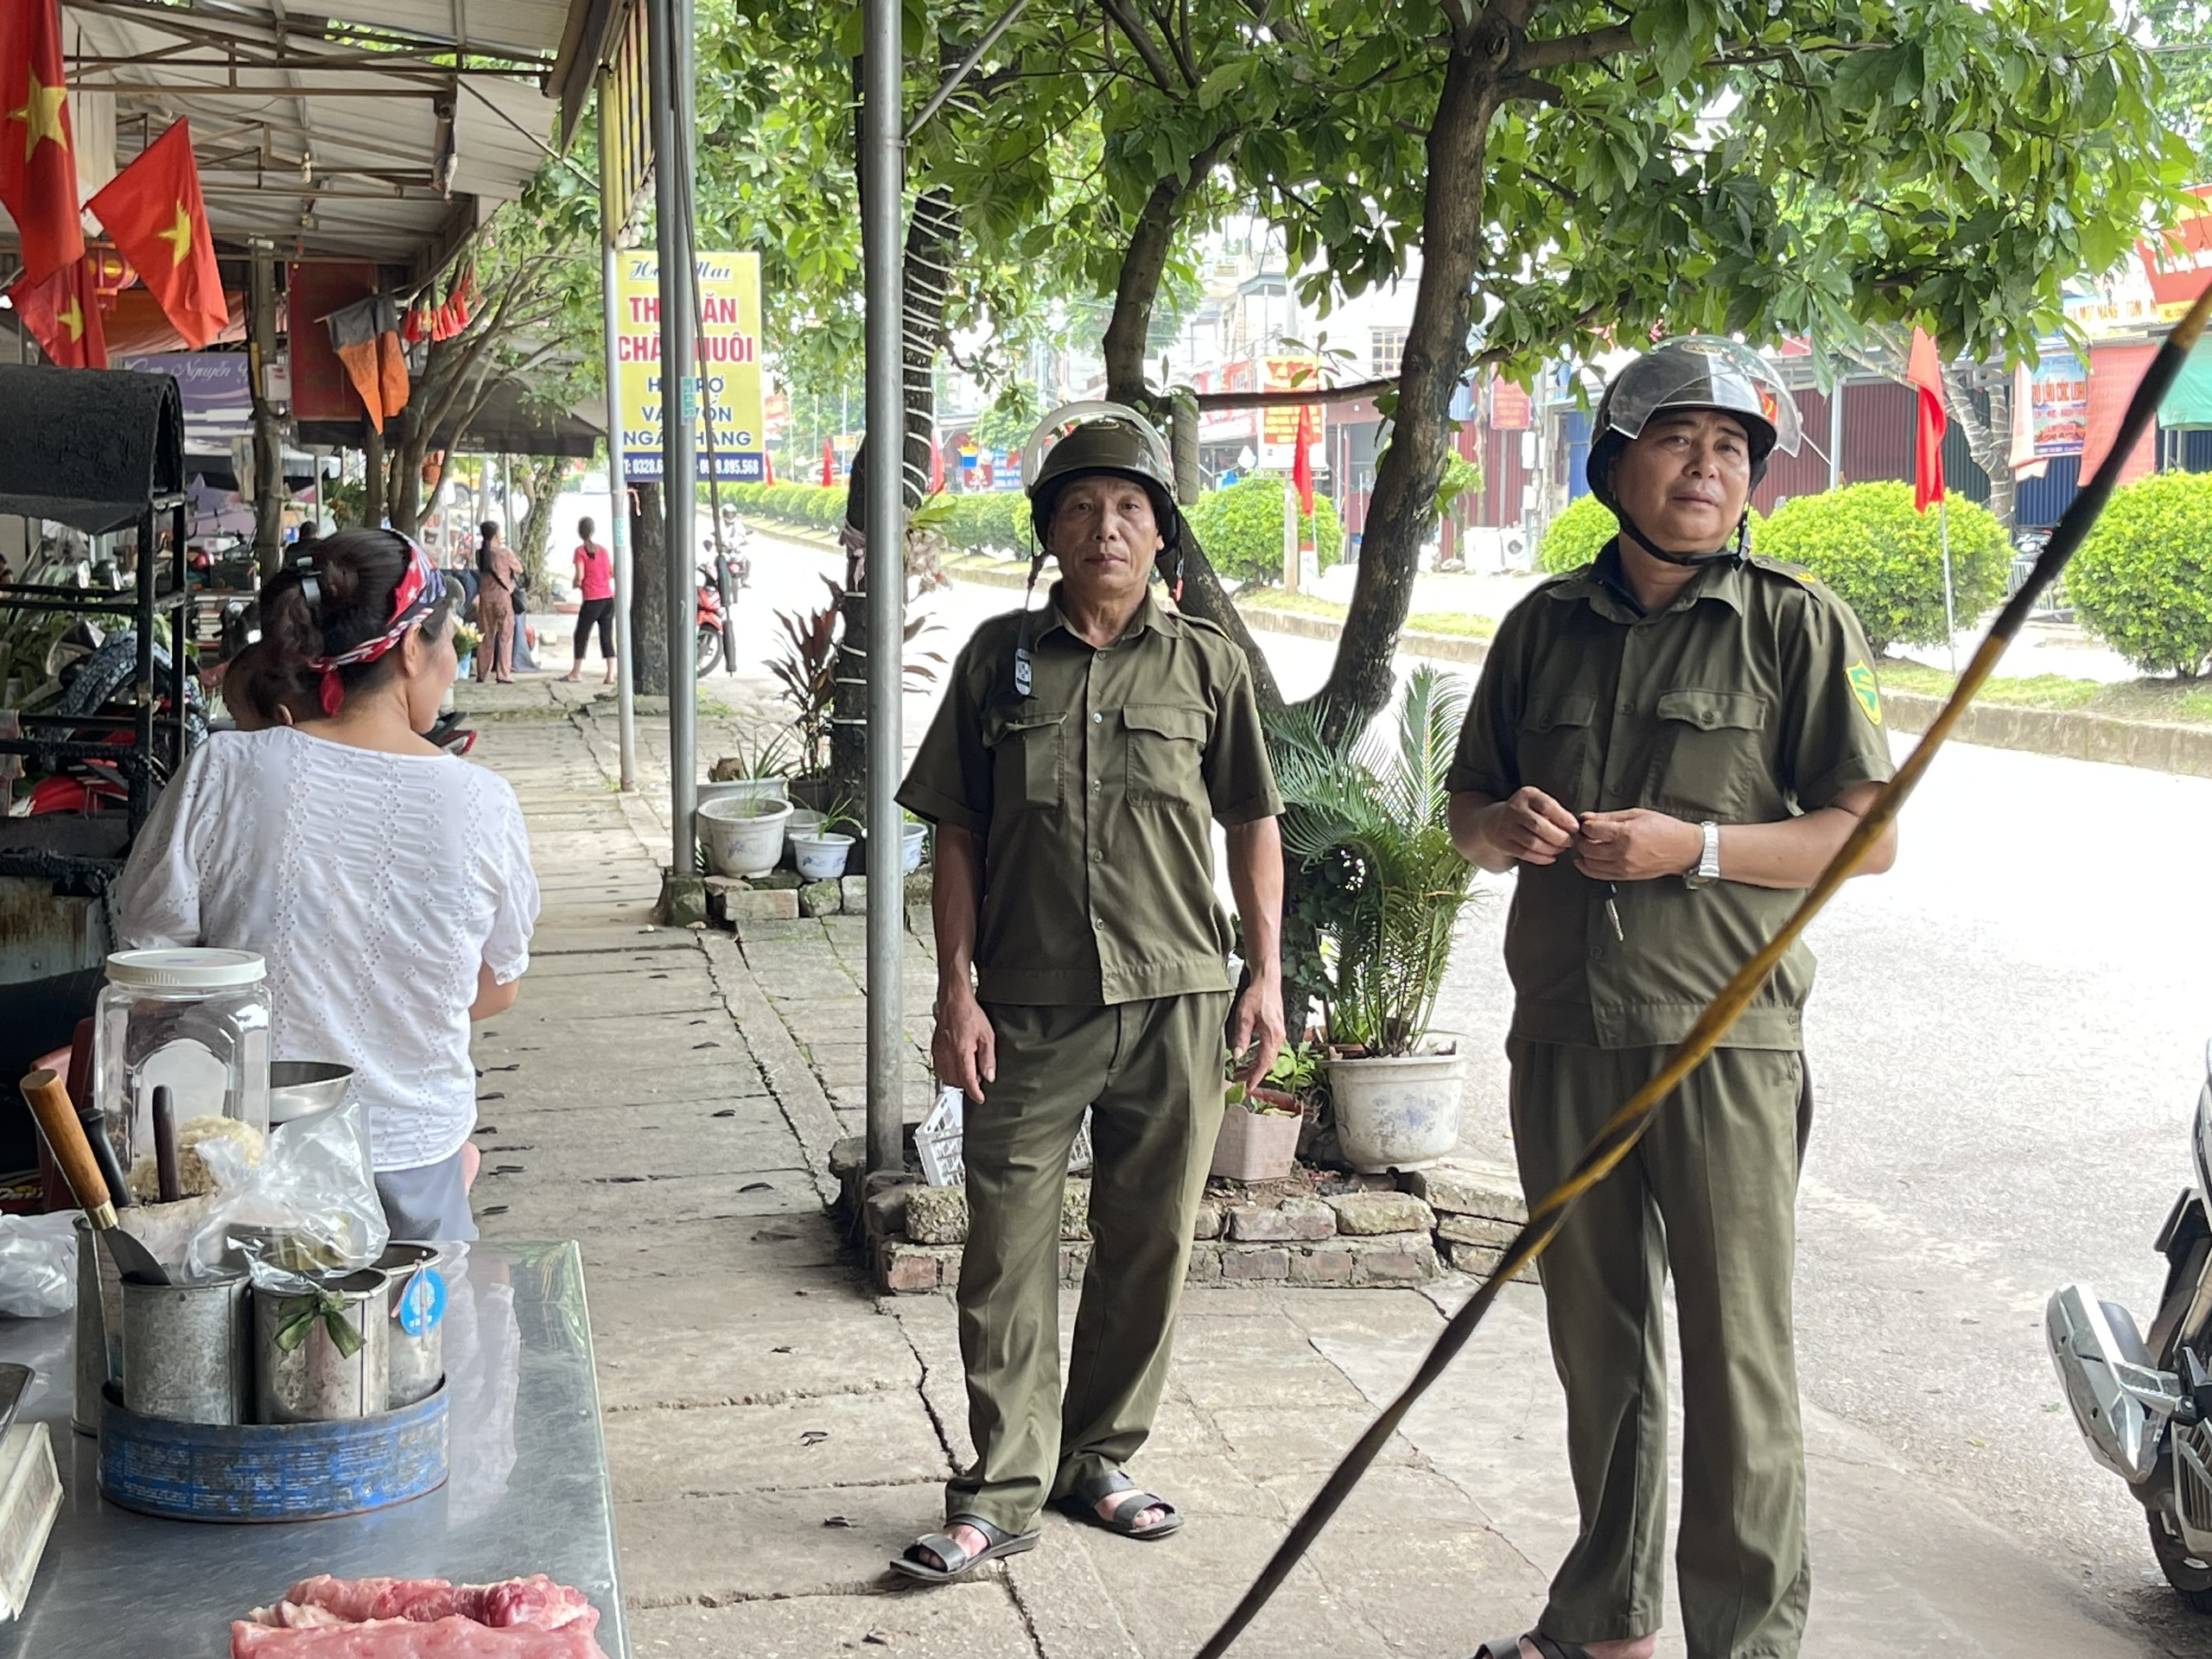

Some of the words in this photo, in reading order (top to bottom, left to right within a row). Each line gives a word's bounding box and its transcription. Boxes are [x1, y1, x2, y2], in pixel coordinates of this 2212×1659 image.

[702, 292, 737, 324] ĂN
[619, 330, 661, 362] CHĂ
[171, 358, 232, 383] Nguyễn
[624, 425, 664, 446] NGÂ
